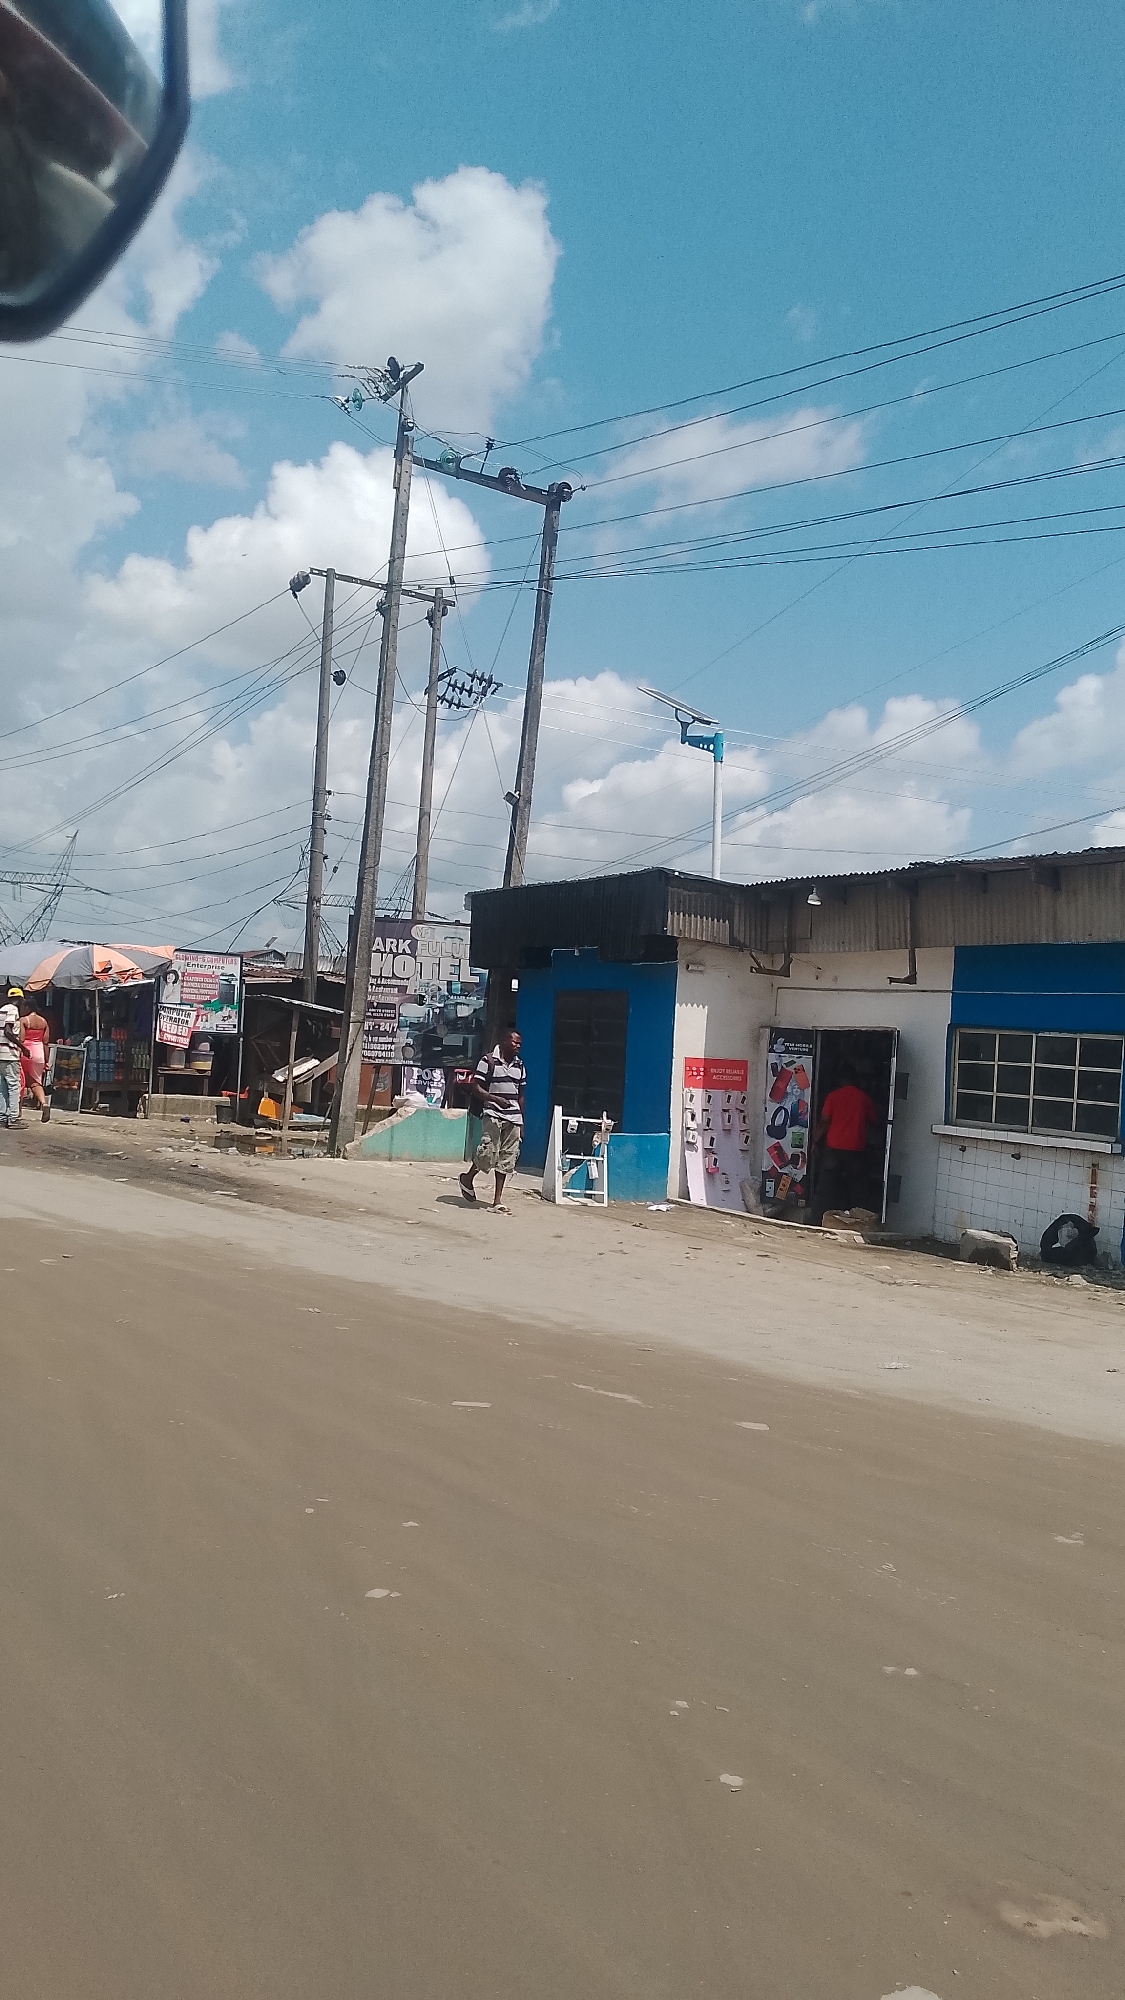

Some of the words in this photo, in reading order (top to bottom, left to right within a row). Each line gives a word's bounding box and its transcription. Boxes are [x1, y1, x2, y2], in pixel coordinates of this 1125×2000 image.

[371, 936, 412, 954] ARK
[186, 961, 226, 971] Enterprise
[370, 952, 480, 983] HOTEL
[159, 1004, 192, 1019] COMPUTER
[379, 1022, 399, 1034] 24/7
[412, 1067, 441, 1081] POS
[409, 1078, 443, 1088] SERVICES
